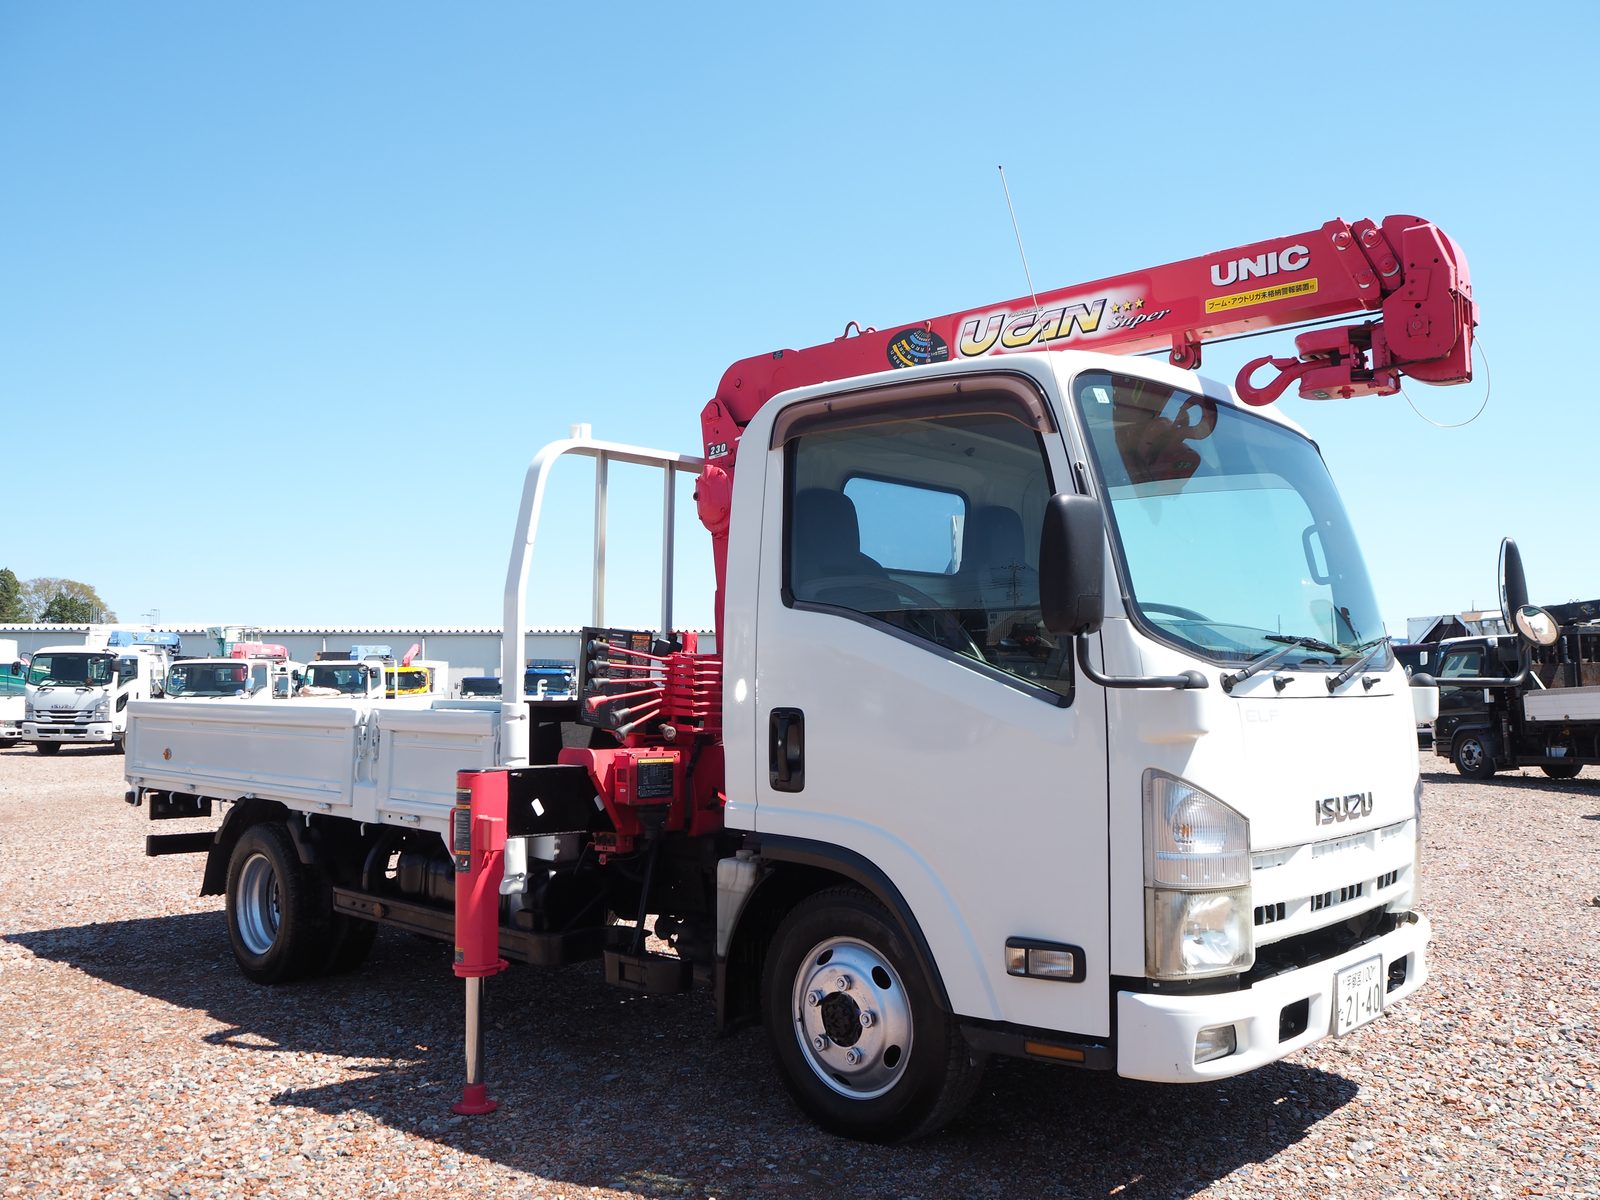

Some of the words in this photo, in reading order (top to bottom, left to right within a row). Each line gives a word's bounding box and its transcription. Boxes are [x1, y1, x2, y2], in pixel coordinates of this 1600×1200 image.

[1210, 244, 1310, 287] UNIC
[960, 298, 1107, 357] UCAN
[1107, 308, 1171, 330] Super
[710, 443, 726, 455] 230
[1245, 709, 1280, 723] ELF
[1315, 791, 1373, 826] ISUZU
